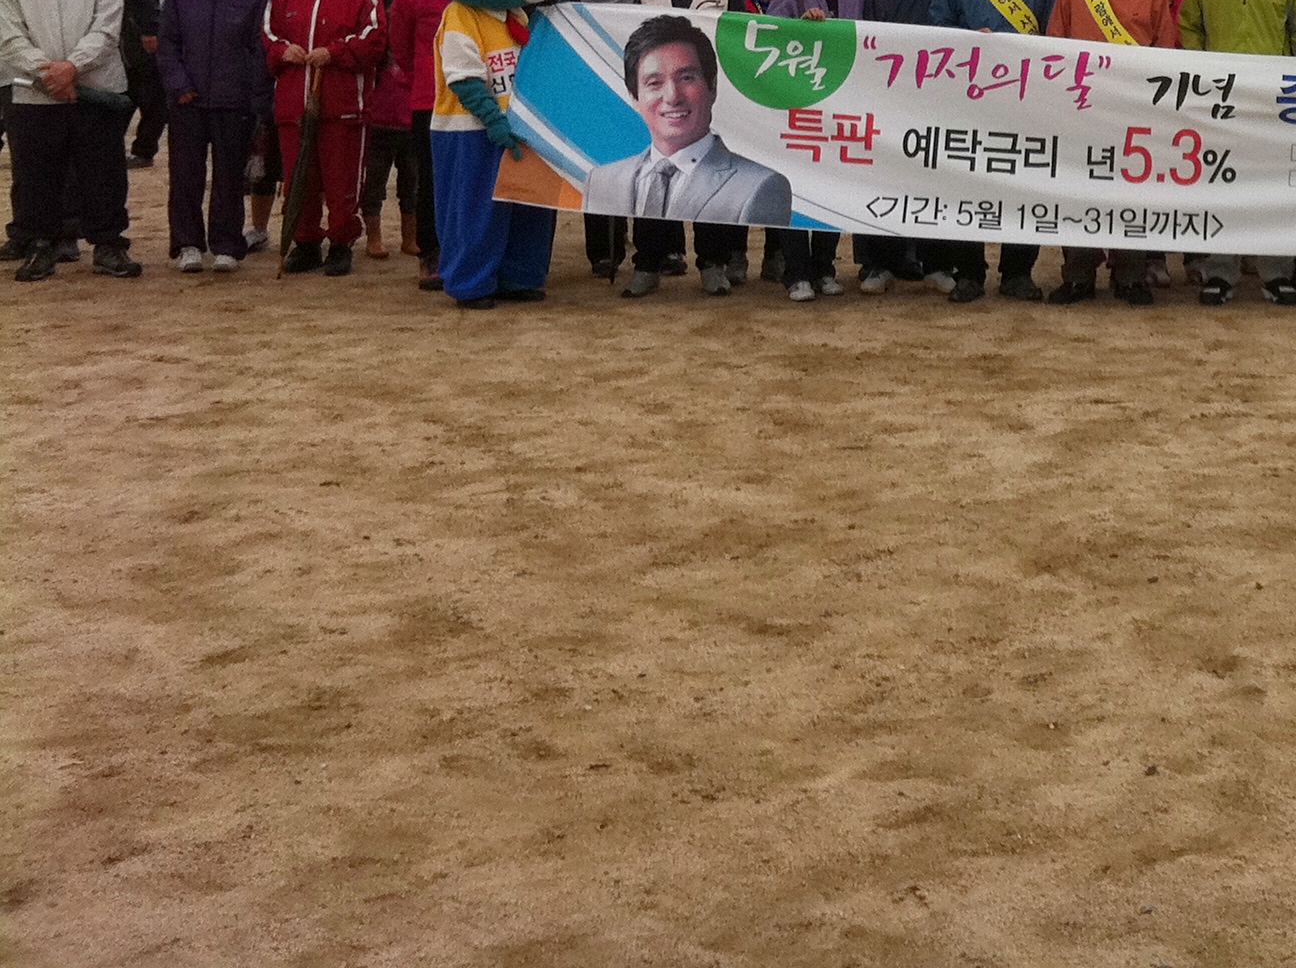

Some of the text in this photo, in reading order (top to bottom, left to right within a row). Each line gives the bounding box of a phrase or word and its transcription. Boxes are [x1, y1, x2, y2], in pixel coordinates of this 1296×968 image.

[744, 20, 828, 91] 5월
[1146, 72, 1236, 120] 기념
[780, 108, 881, 165] 특판
[902, 126, 1059, 178] 예탁금리
[956, 200, 1003, 231] 5월
